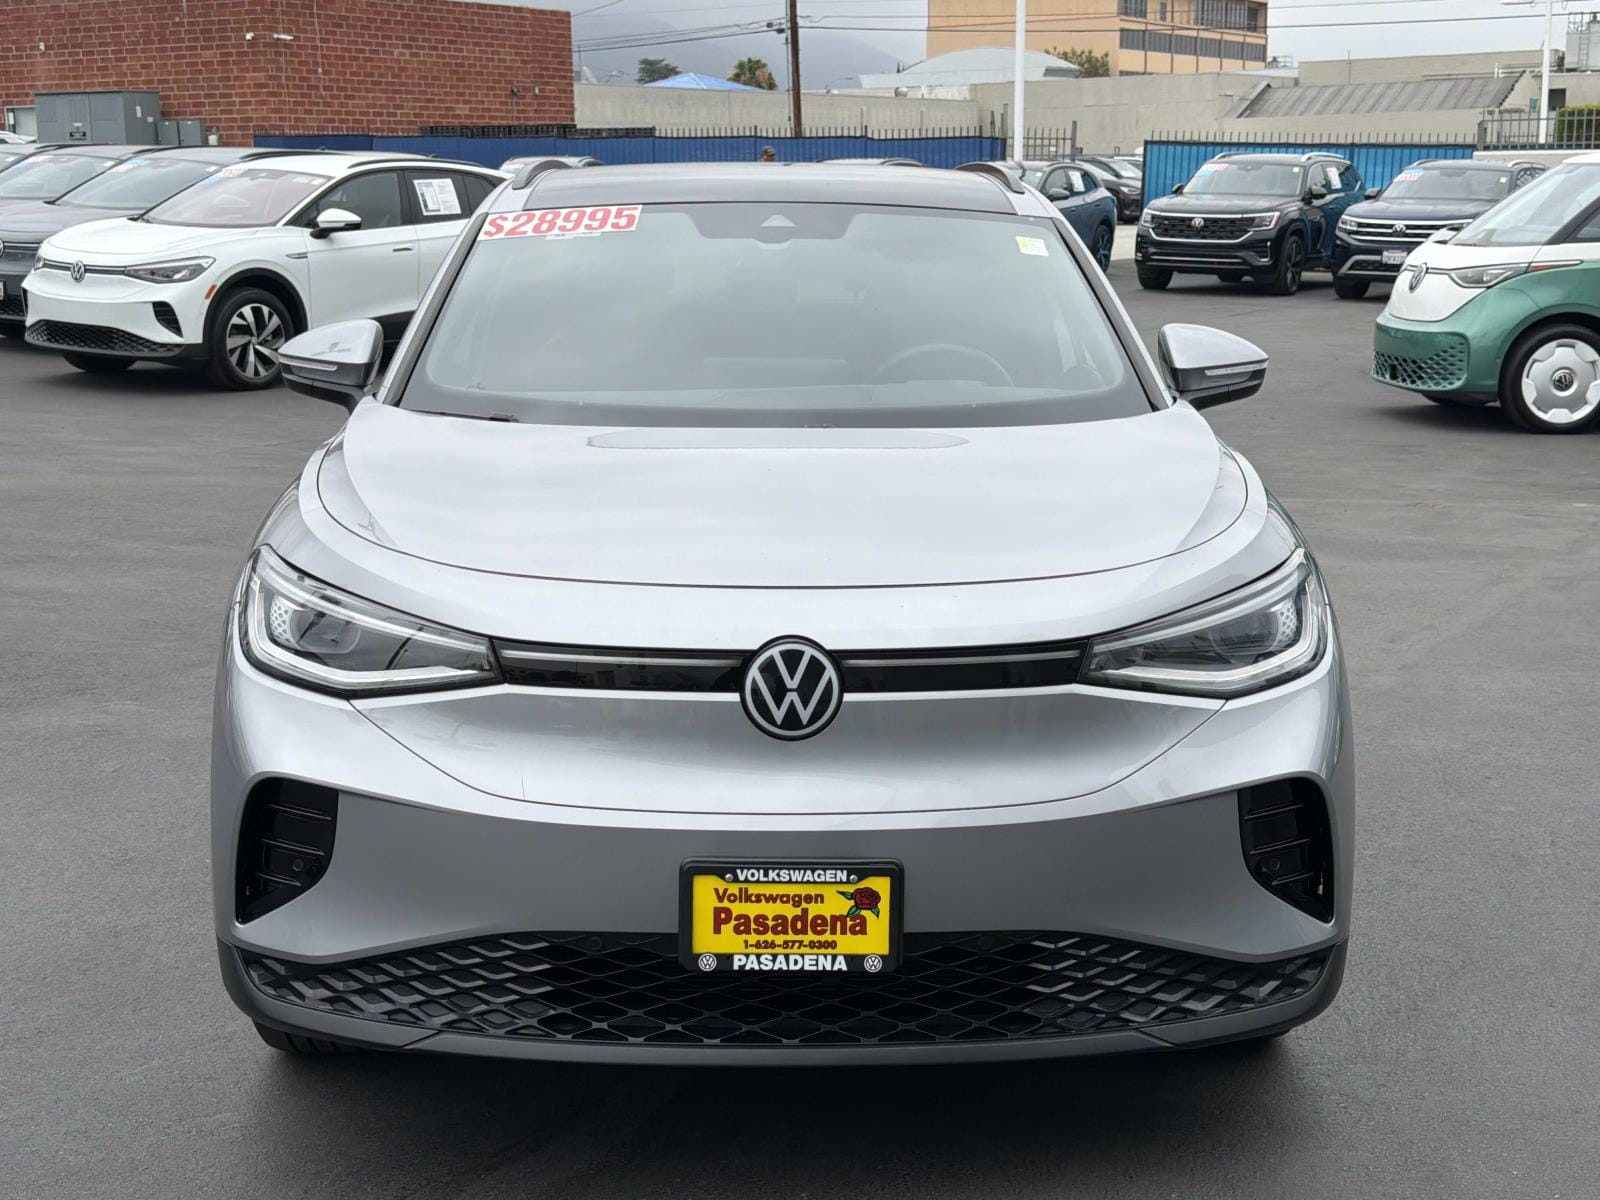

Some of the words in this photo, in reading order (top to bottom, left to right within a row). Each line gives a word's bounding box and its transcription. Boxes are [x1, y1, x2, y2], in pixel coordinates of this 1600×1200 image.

[483, 206, 639, 238] $28995
[745, 642, 839, 736] VW
[736, 869, 847, 882] VOLKSWAGEN
[713, 887, 825, 907] Volkswagen
[713, 907, 867, 935] Pasadena
[743, 940, 837, 950] 1-626-577-0300
[733, 954, 847, 971] PASADENA
